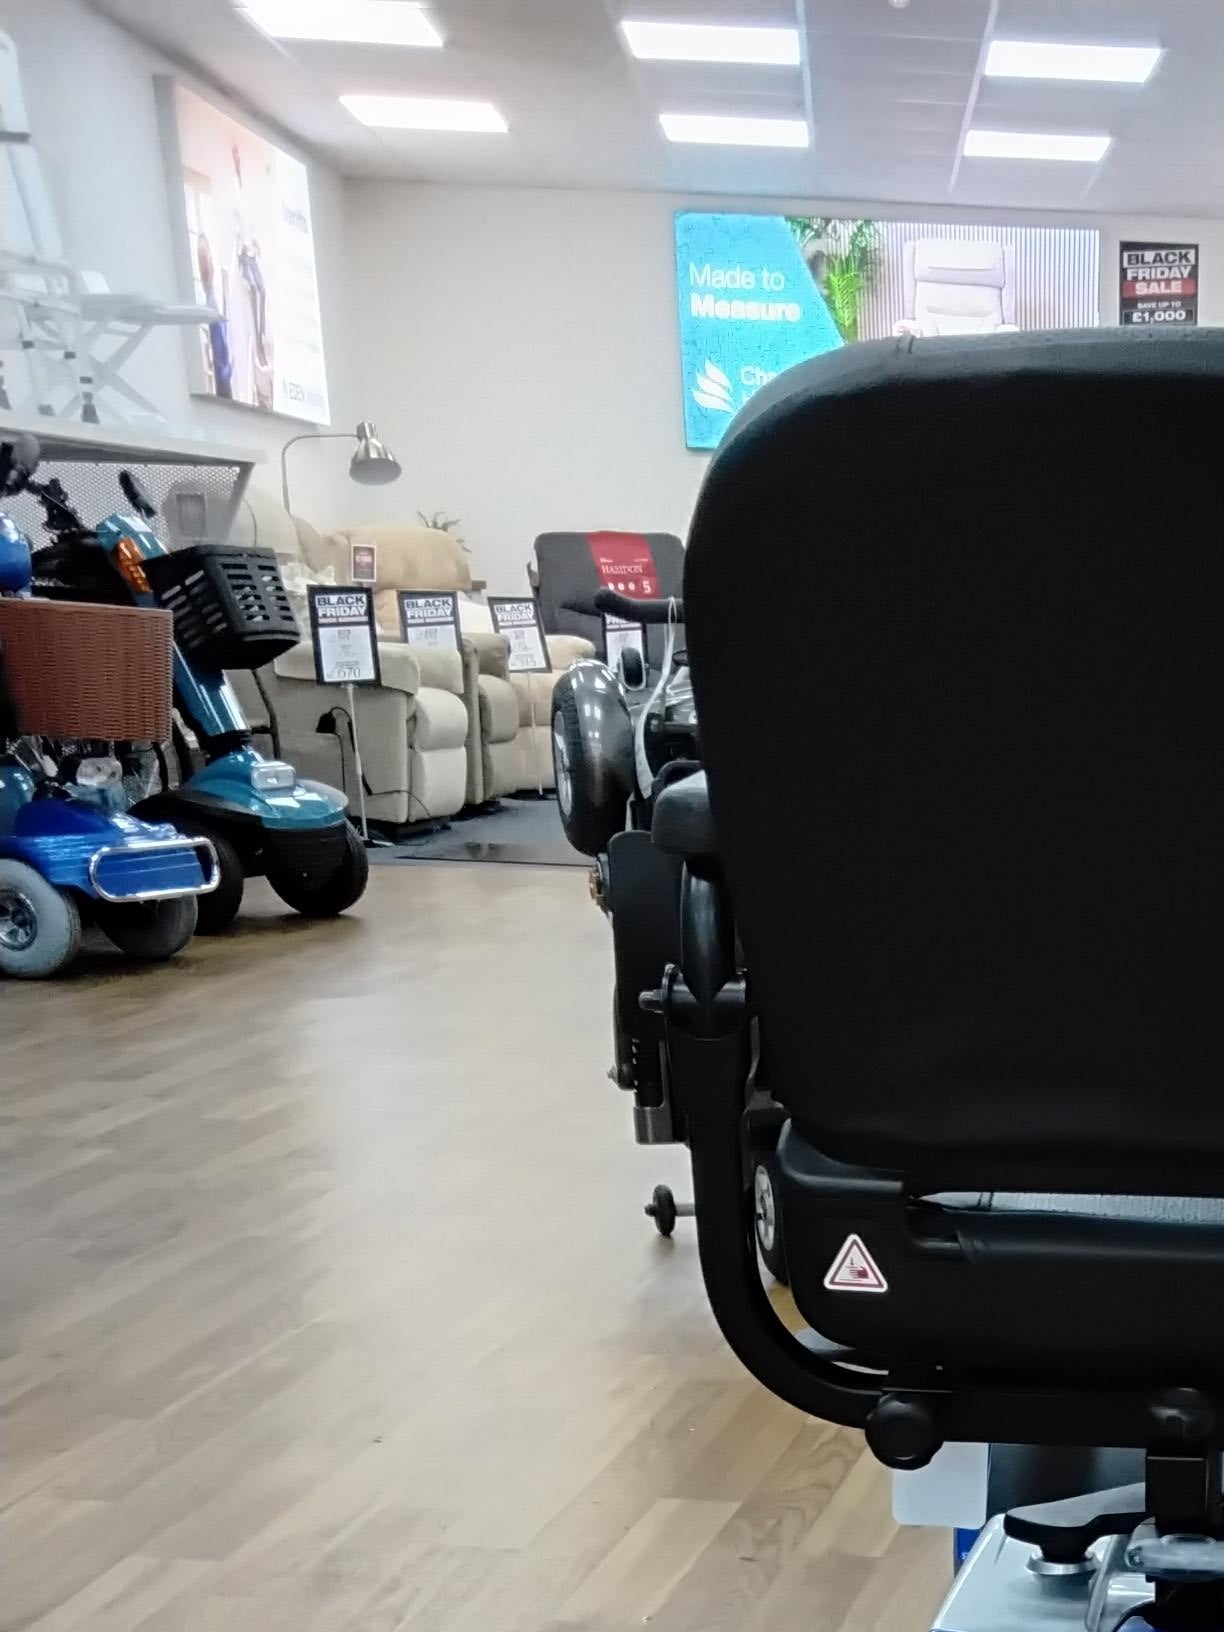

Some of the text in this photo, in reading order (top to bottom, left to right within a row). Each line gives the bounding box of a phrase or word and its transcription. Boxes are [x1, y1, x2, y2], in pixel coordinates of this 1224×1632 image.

[1127, 251, 1191, 265] BLACK
[689, 262, 785, 291] Made to
[1126, 265, 1192, 281] FRIDAY
[1135, 280, 1182, 295] SALE
[690, 292, 801, 322] Measure
[1132, 310, 1186, 323] £1,000
[317, 595, 365, 606] BLACK
[405, 600, 452, 609] BLACK
[318, 606, 367, 618] FRIDAY
[406, 607, 452, 619] FRIDAY
[496, 605, 533, 613] BLACK
[497, 612, 534, 621] FRIDAY
